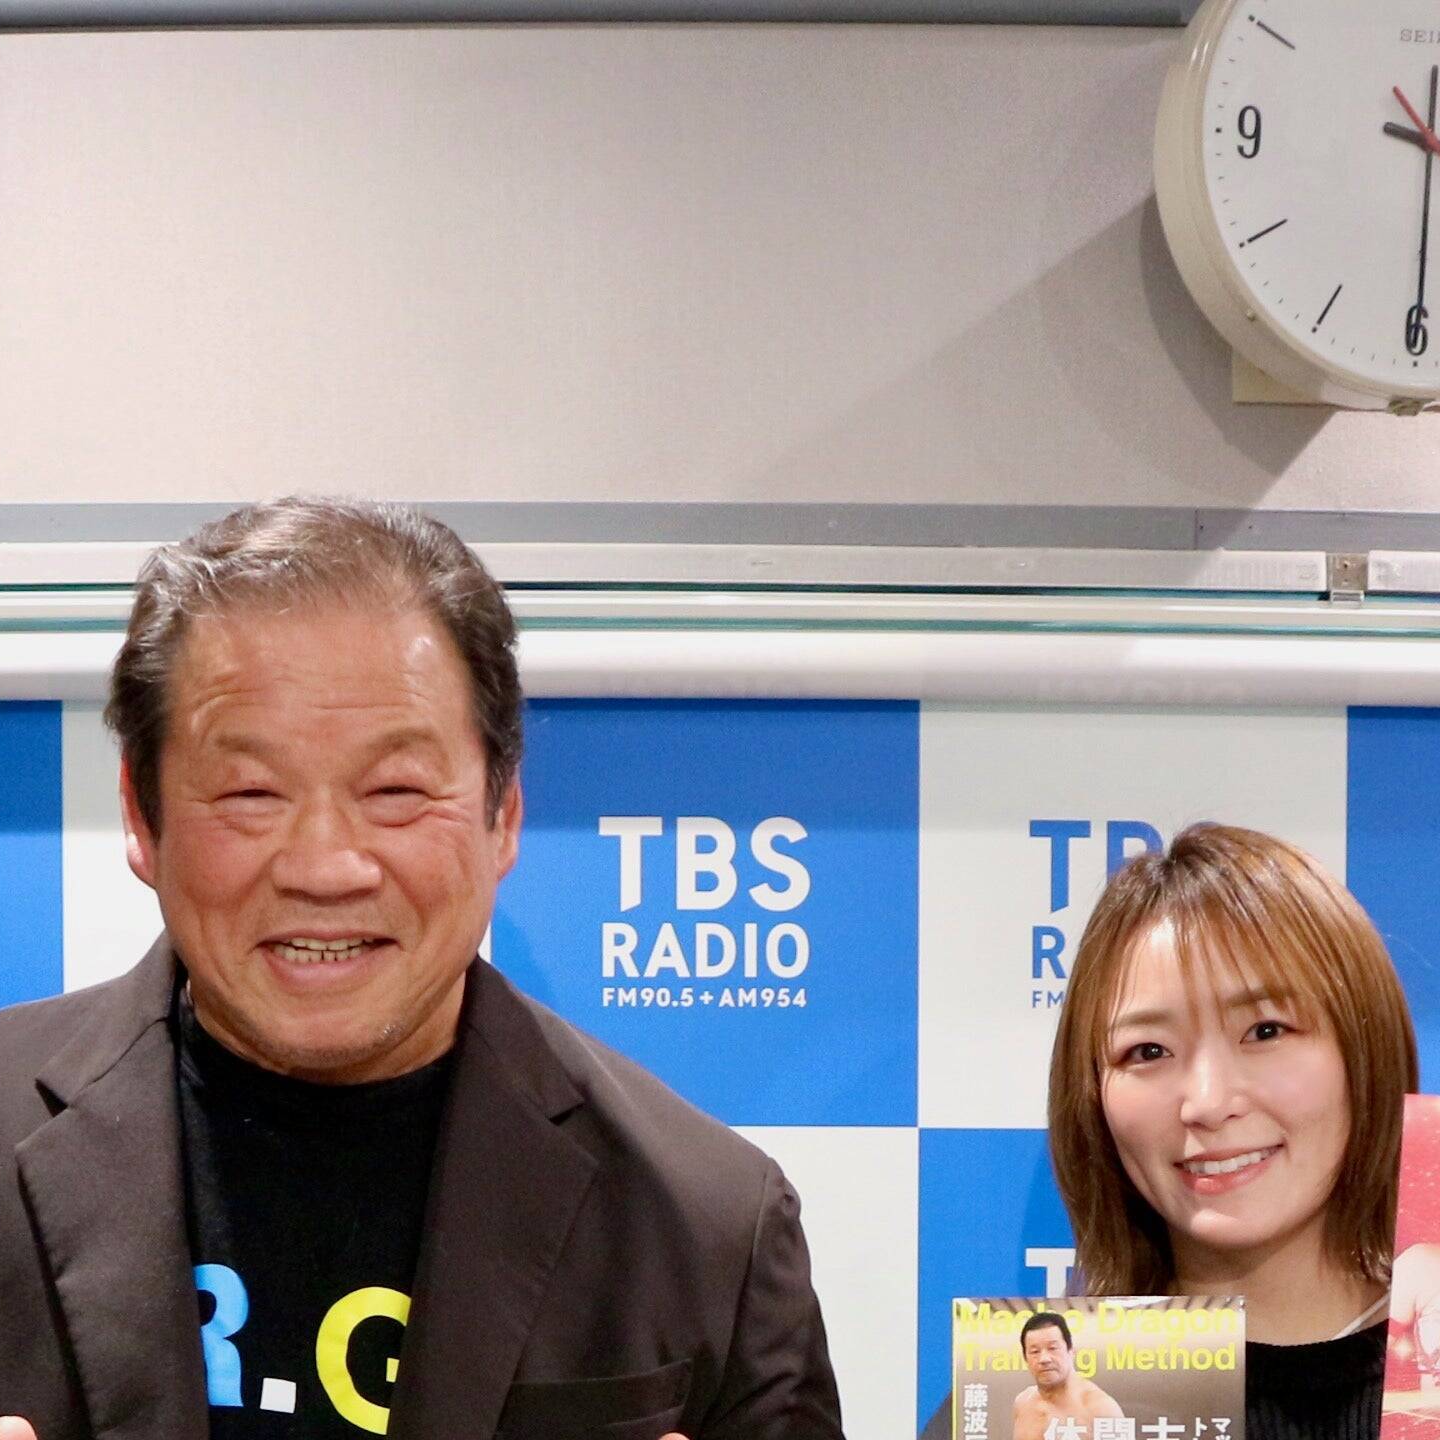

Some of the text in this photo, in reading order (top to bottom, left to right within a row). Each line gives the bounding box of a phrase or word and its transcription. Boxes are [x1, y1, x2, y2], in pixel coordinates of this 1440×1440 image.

[1237, 105, 1262, 159] 9
[1404, 303, 1429, 356] 6
[598, 816, 812, 914] TBS
[601, 922, 811, 979] RADIO
[959, 1302, 1239, 1343] Maco Dragon
[1106, 1343, 1237, 1371] Method
